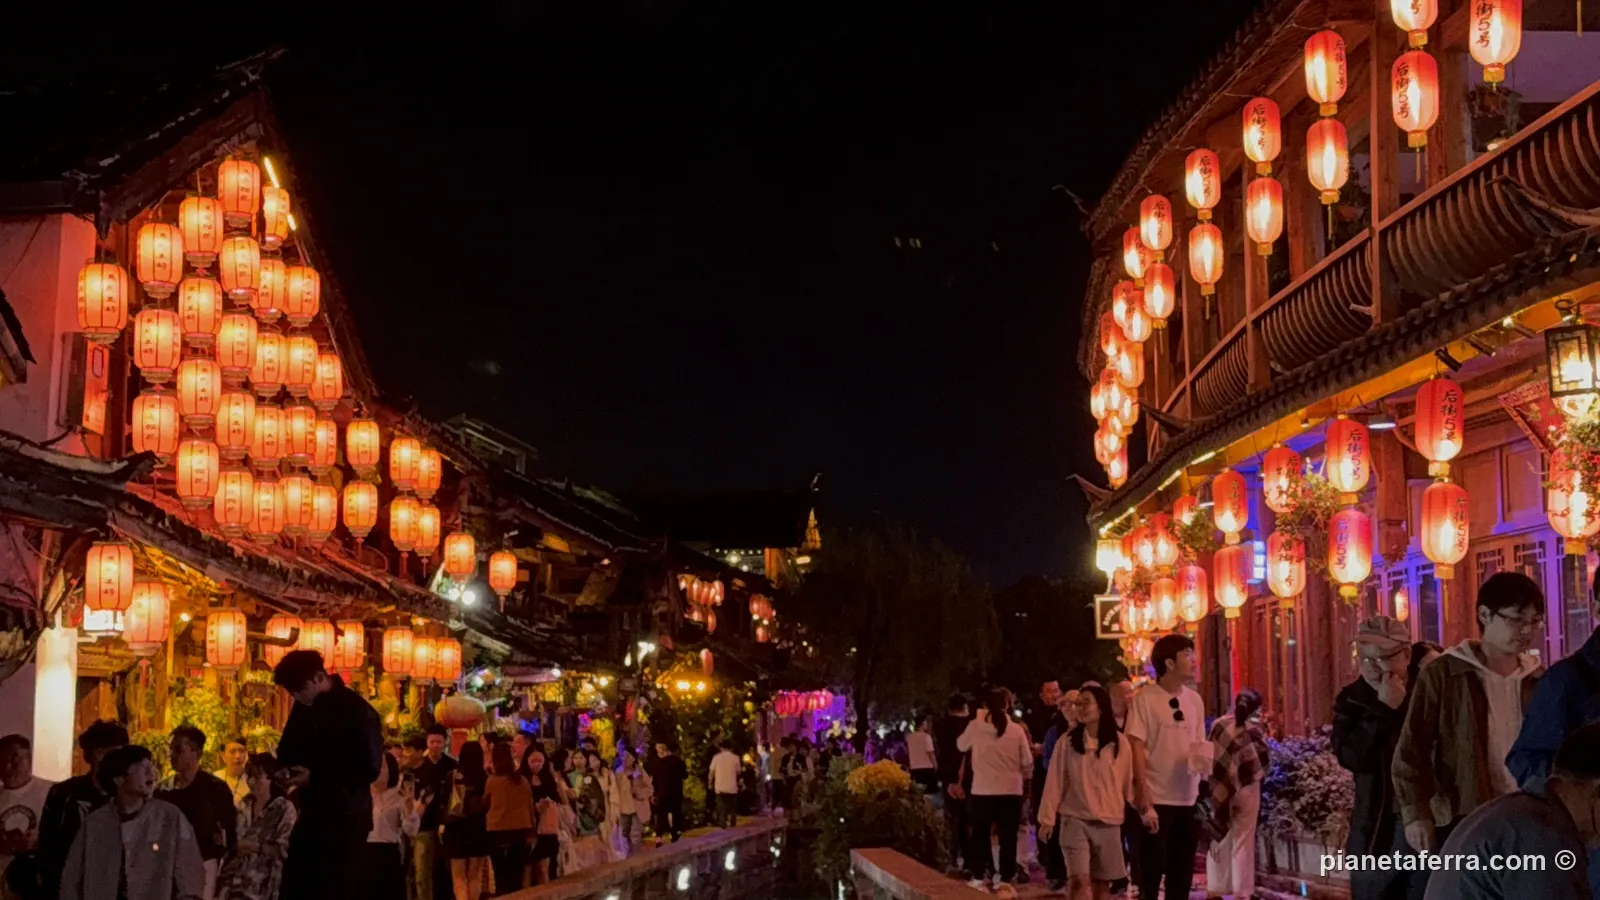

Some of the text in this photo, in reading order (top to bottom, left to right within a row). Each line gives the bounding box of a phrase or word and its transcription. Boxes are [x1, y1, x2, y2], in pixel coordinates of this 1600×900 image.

[1475, 0, 1495, 48] 街5号
[1348, 428, 1362, 481] 后街5号
